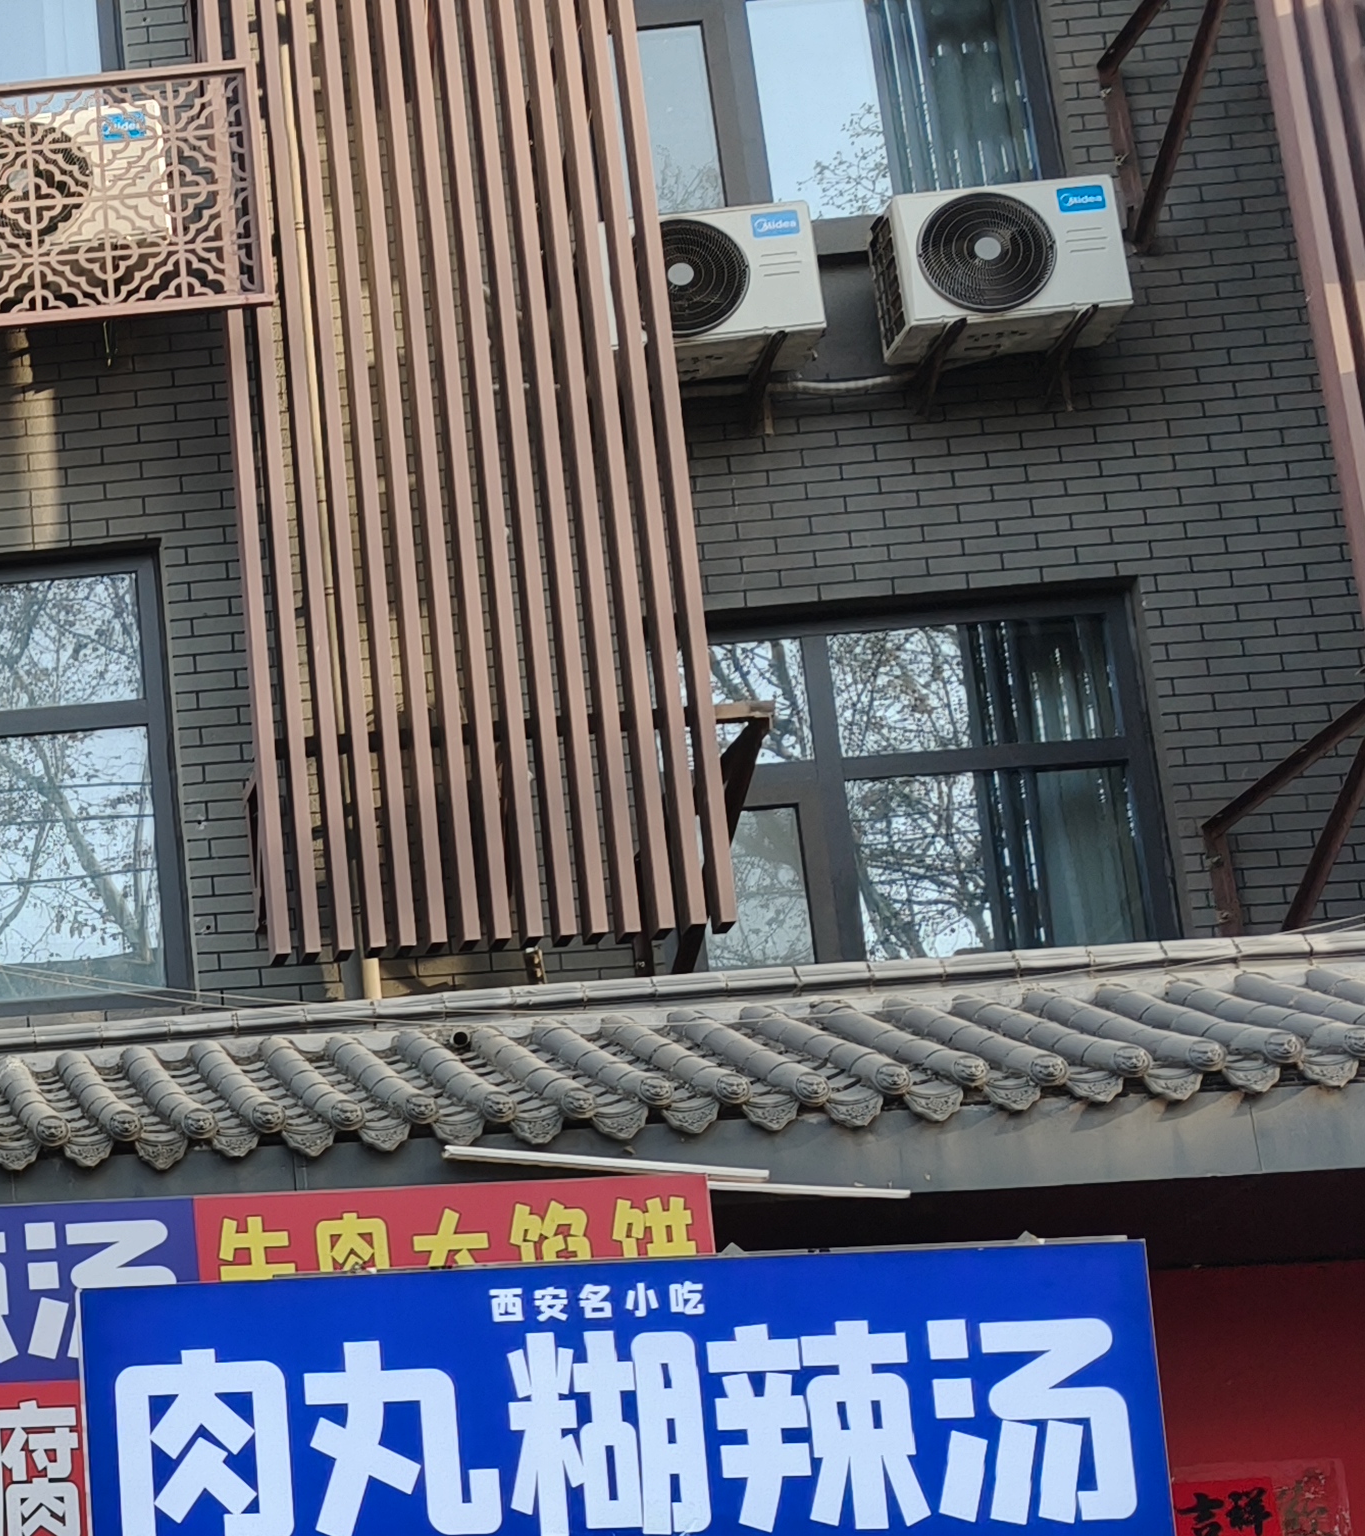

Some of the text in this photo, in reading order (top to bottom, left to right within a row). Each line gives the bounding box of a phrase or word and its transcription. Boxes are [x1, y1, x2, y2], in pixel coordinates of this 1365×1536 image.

[1060, 193, 1103, 207] Midea
[754, 218, 797, 231] Midea
[491, 1281, 705, 1322] 西安名小吃
